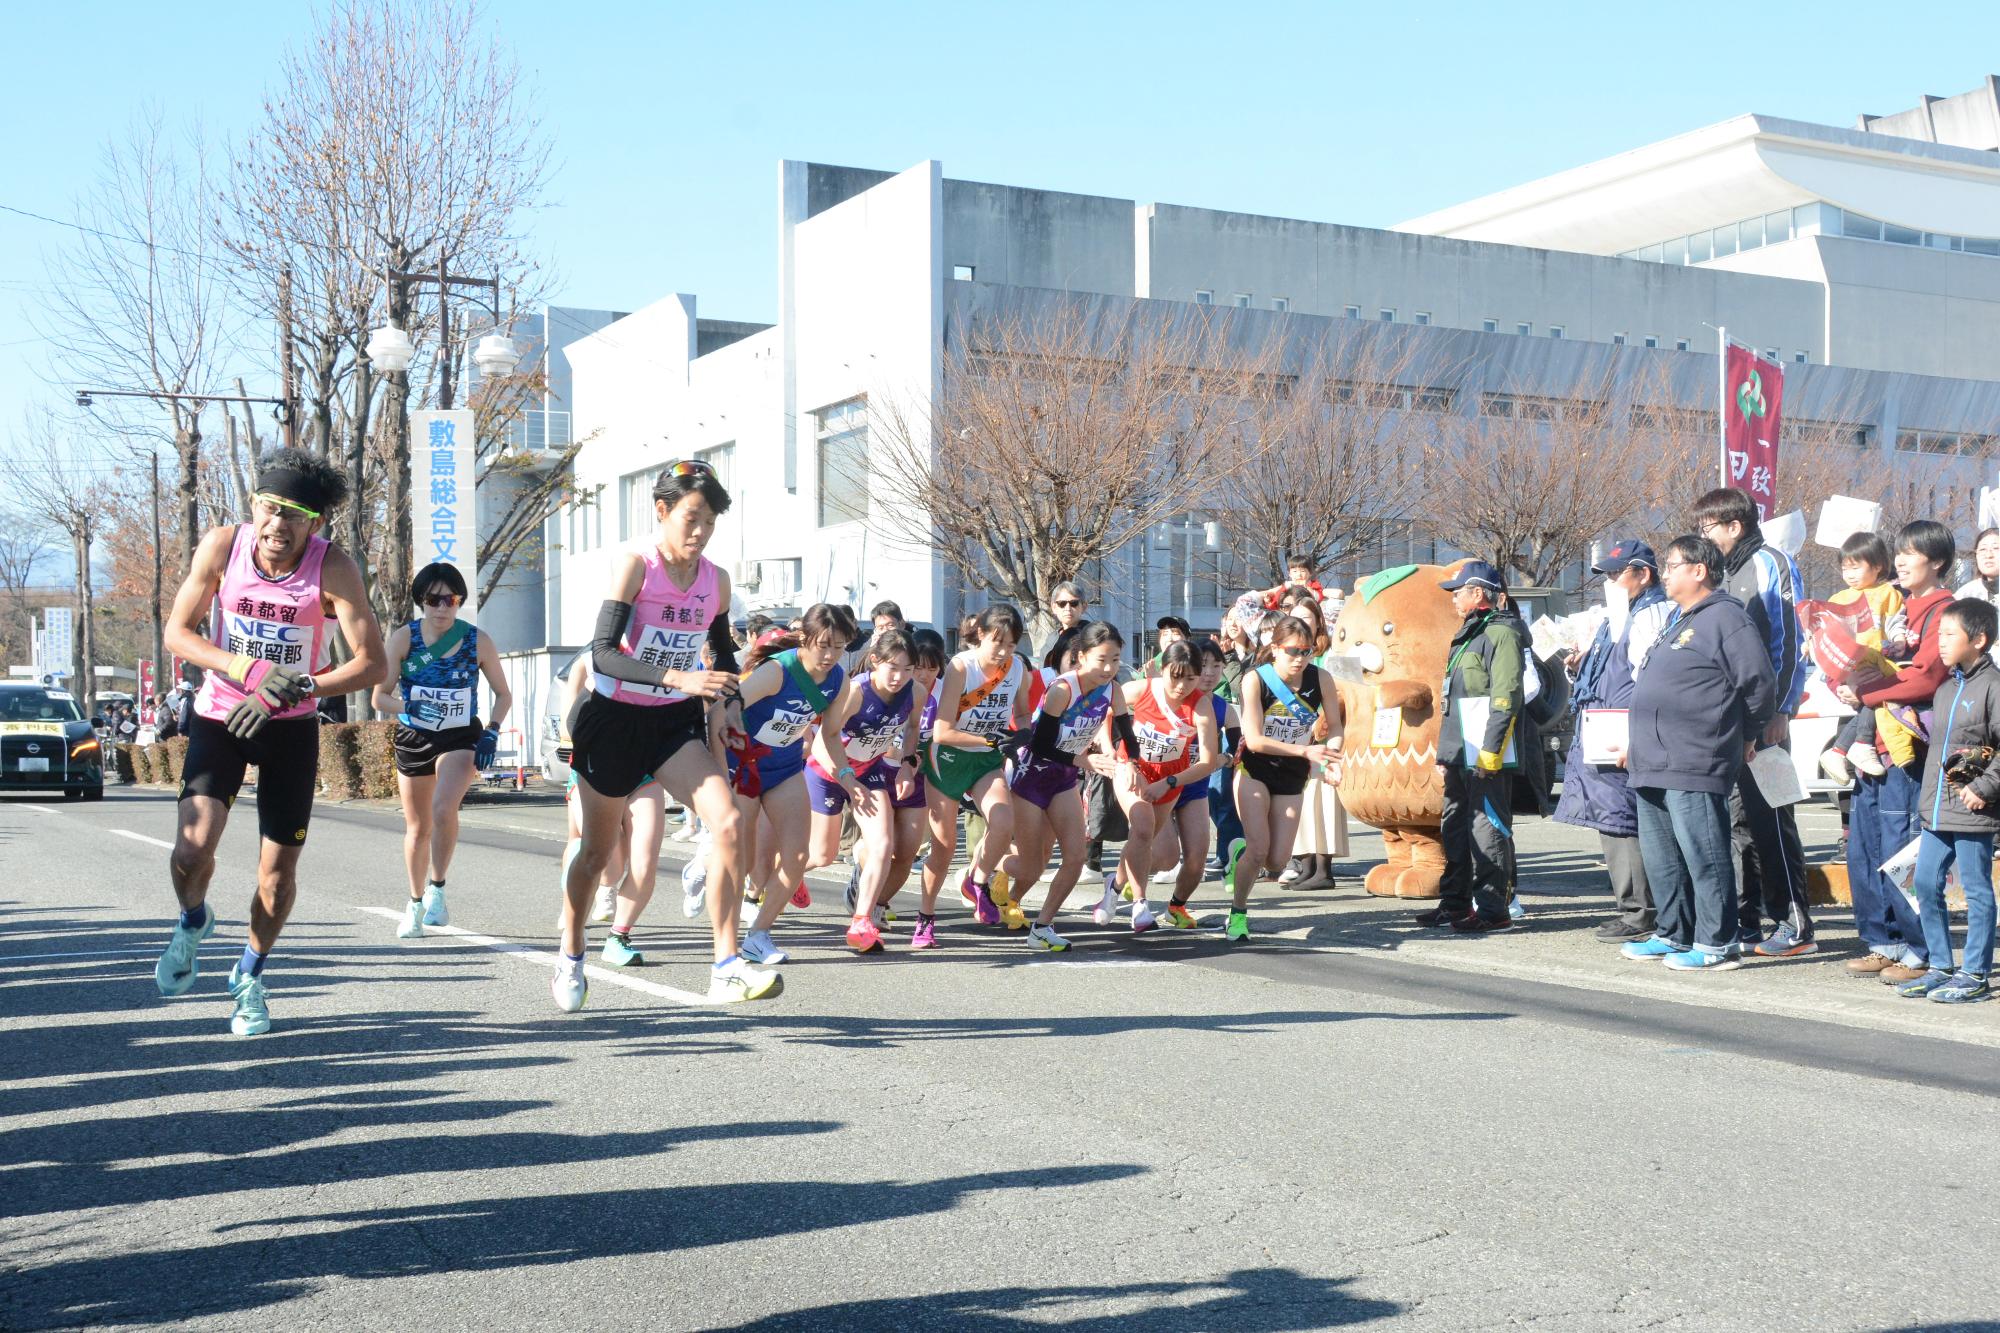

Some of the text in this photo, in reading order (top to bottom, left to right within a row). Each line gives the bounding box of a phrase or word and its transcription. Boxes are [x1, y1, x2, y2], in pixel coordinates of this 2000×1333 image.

[237, 597, 298, 623] 南都留
[661, 604, 704, 626] 南都留
[234, 616, 300, 643] NEC
[650, 630, 702, 648] NEC
[228, 632, 303, 665] 南都留郡
[419, 688, 465, 702] NEC
[970, 708, 1009, 720] NEC
[1140, 727, 1178, 745] NEC
[1145, 752, 1164, 762] 11
